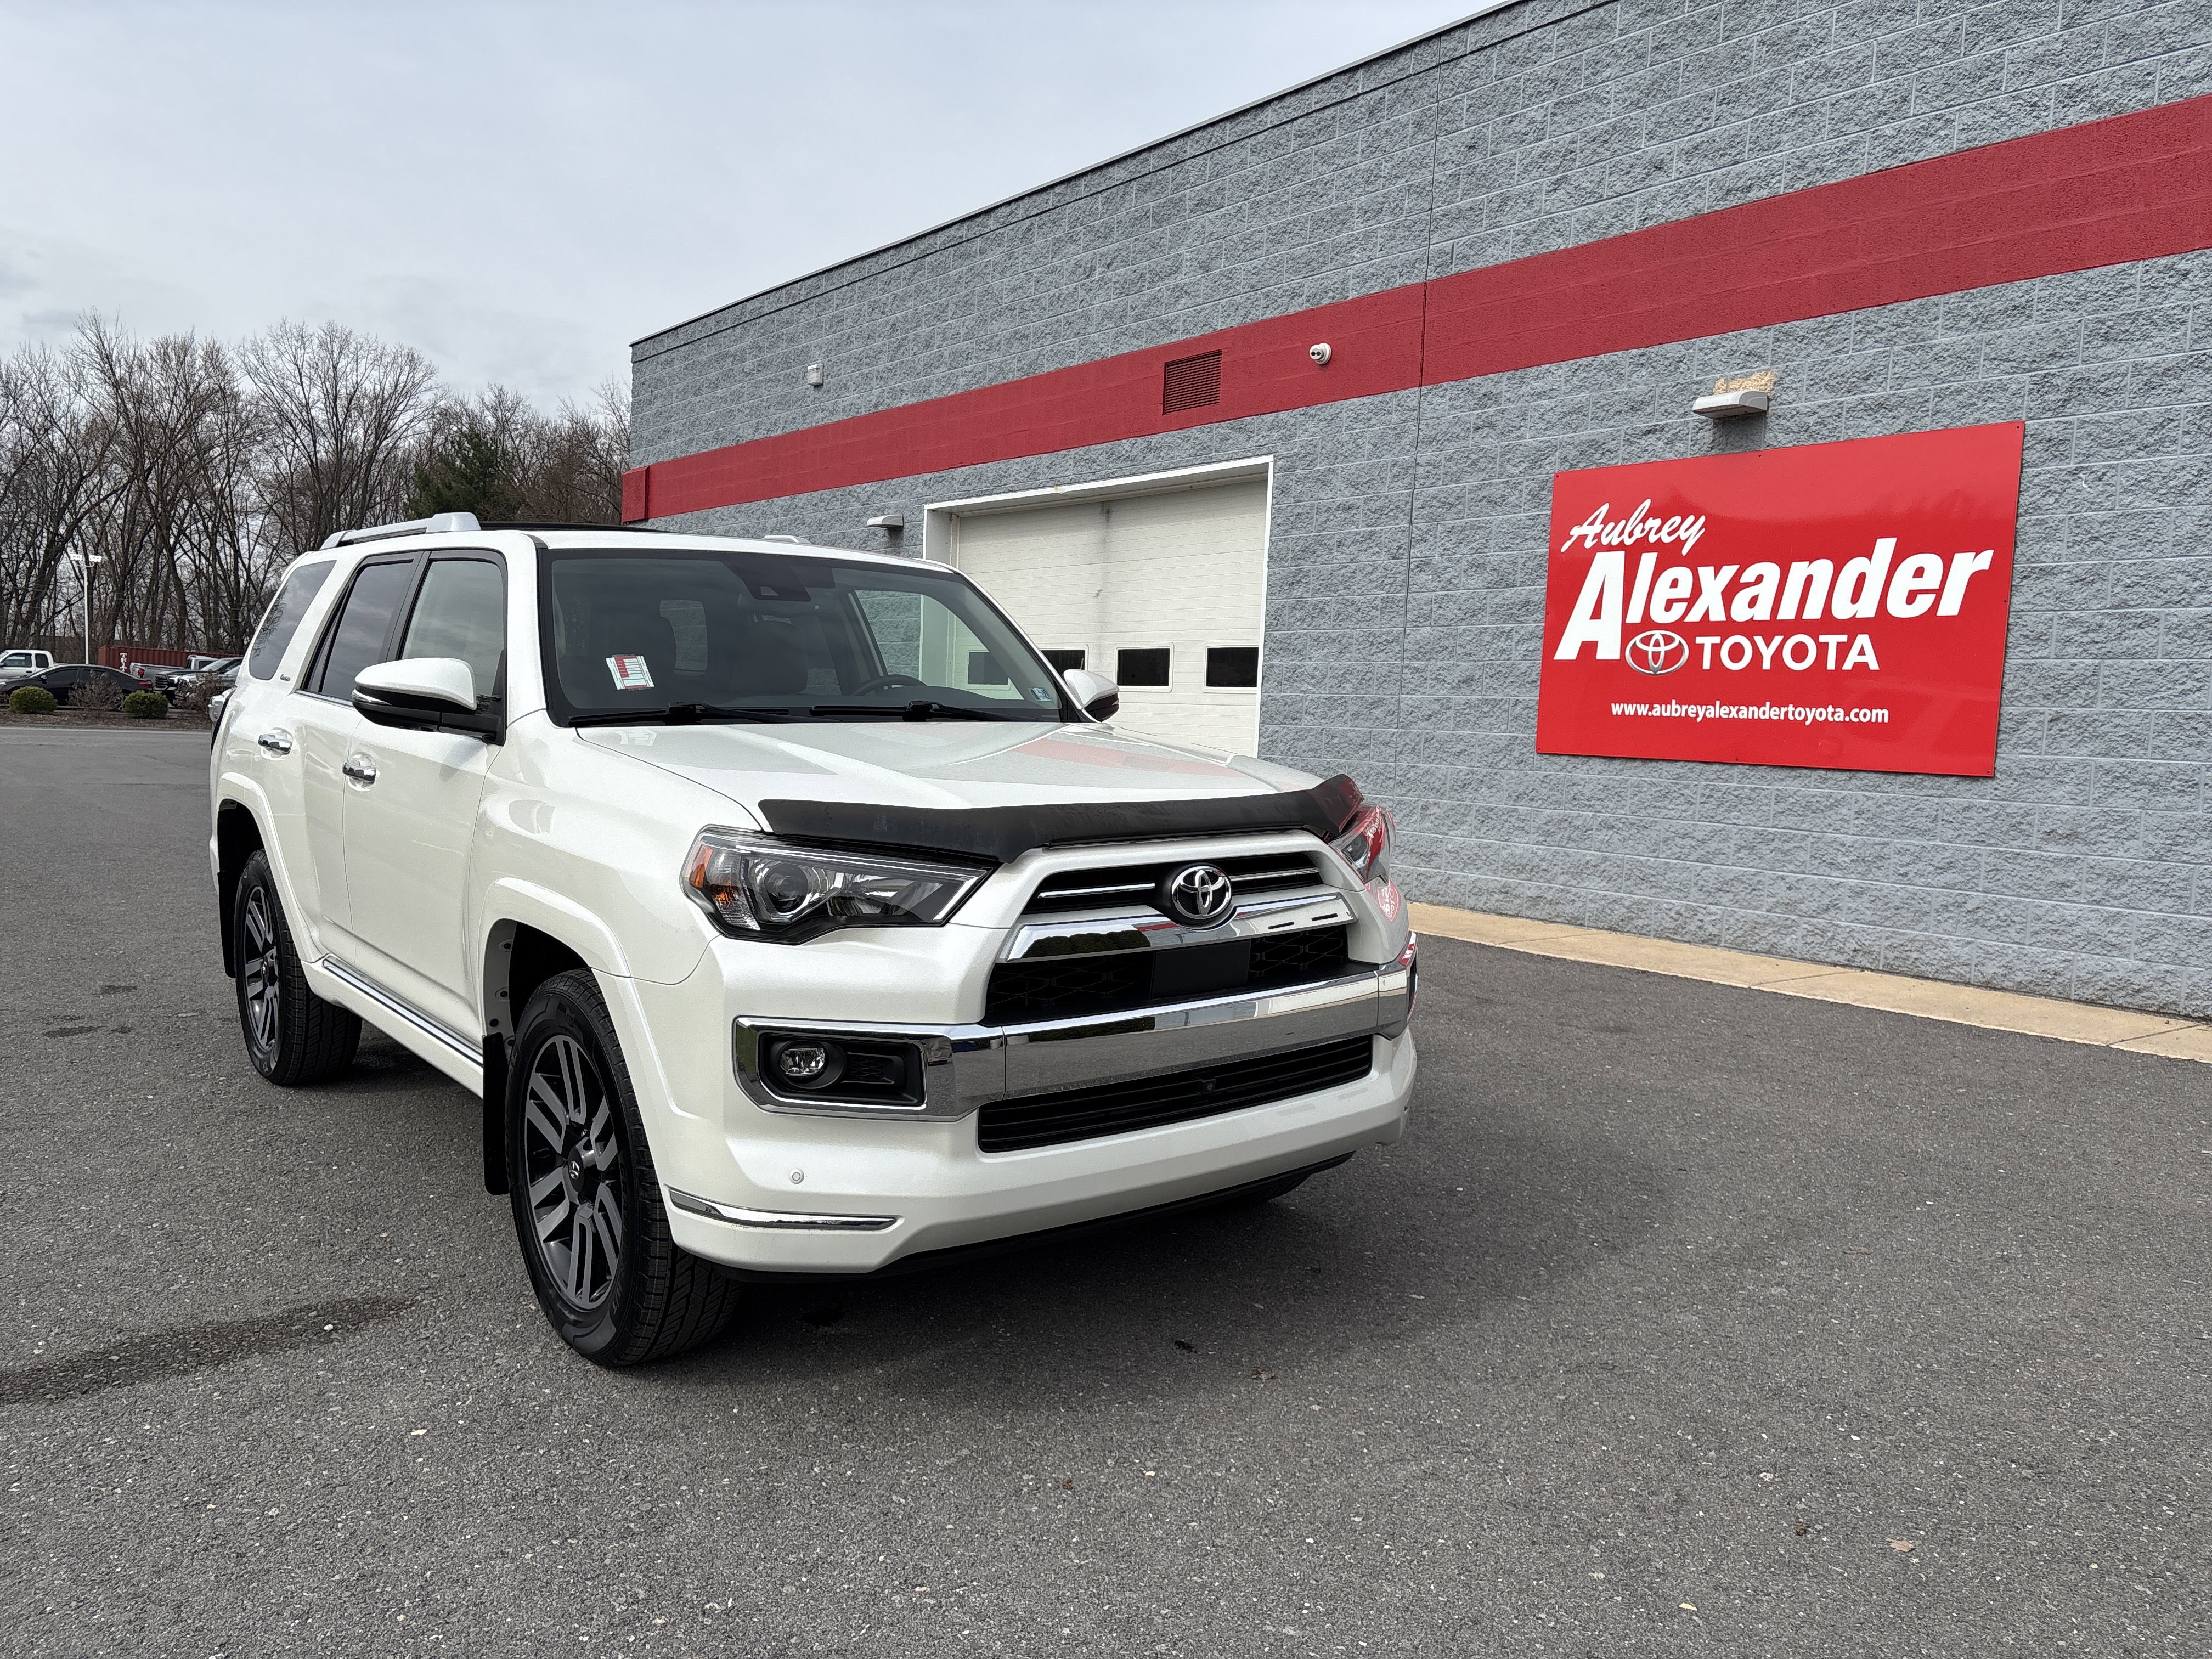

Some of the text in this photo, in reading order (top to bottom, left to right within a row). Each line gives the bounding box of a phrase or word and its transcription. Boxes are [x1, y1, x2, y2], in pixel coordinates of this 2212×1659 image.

[1560, 498, 1706, 556] Aubrey
[1553, 537, 1994, 661] Alexander
[1695, 634, 1880, 671] TOYOTA
[1611, 699, 1889, 726] www.aubreyalexandertoyota.com
